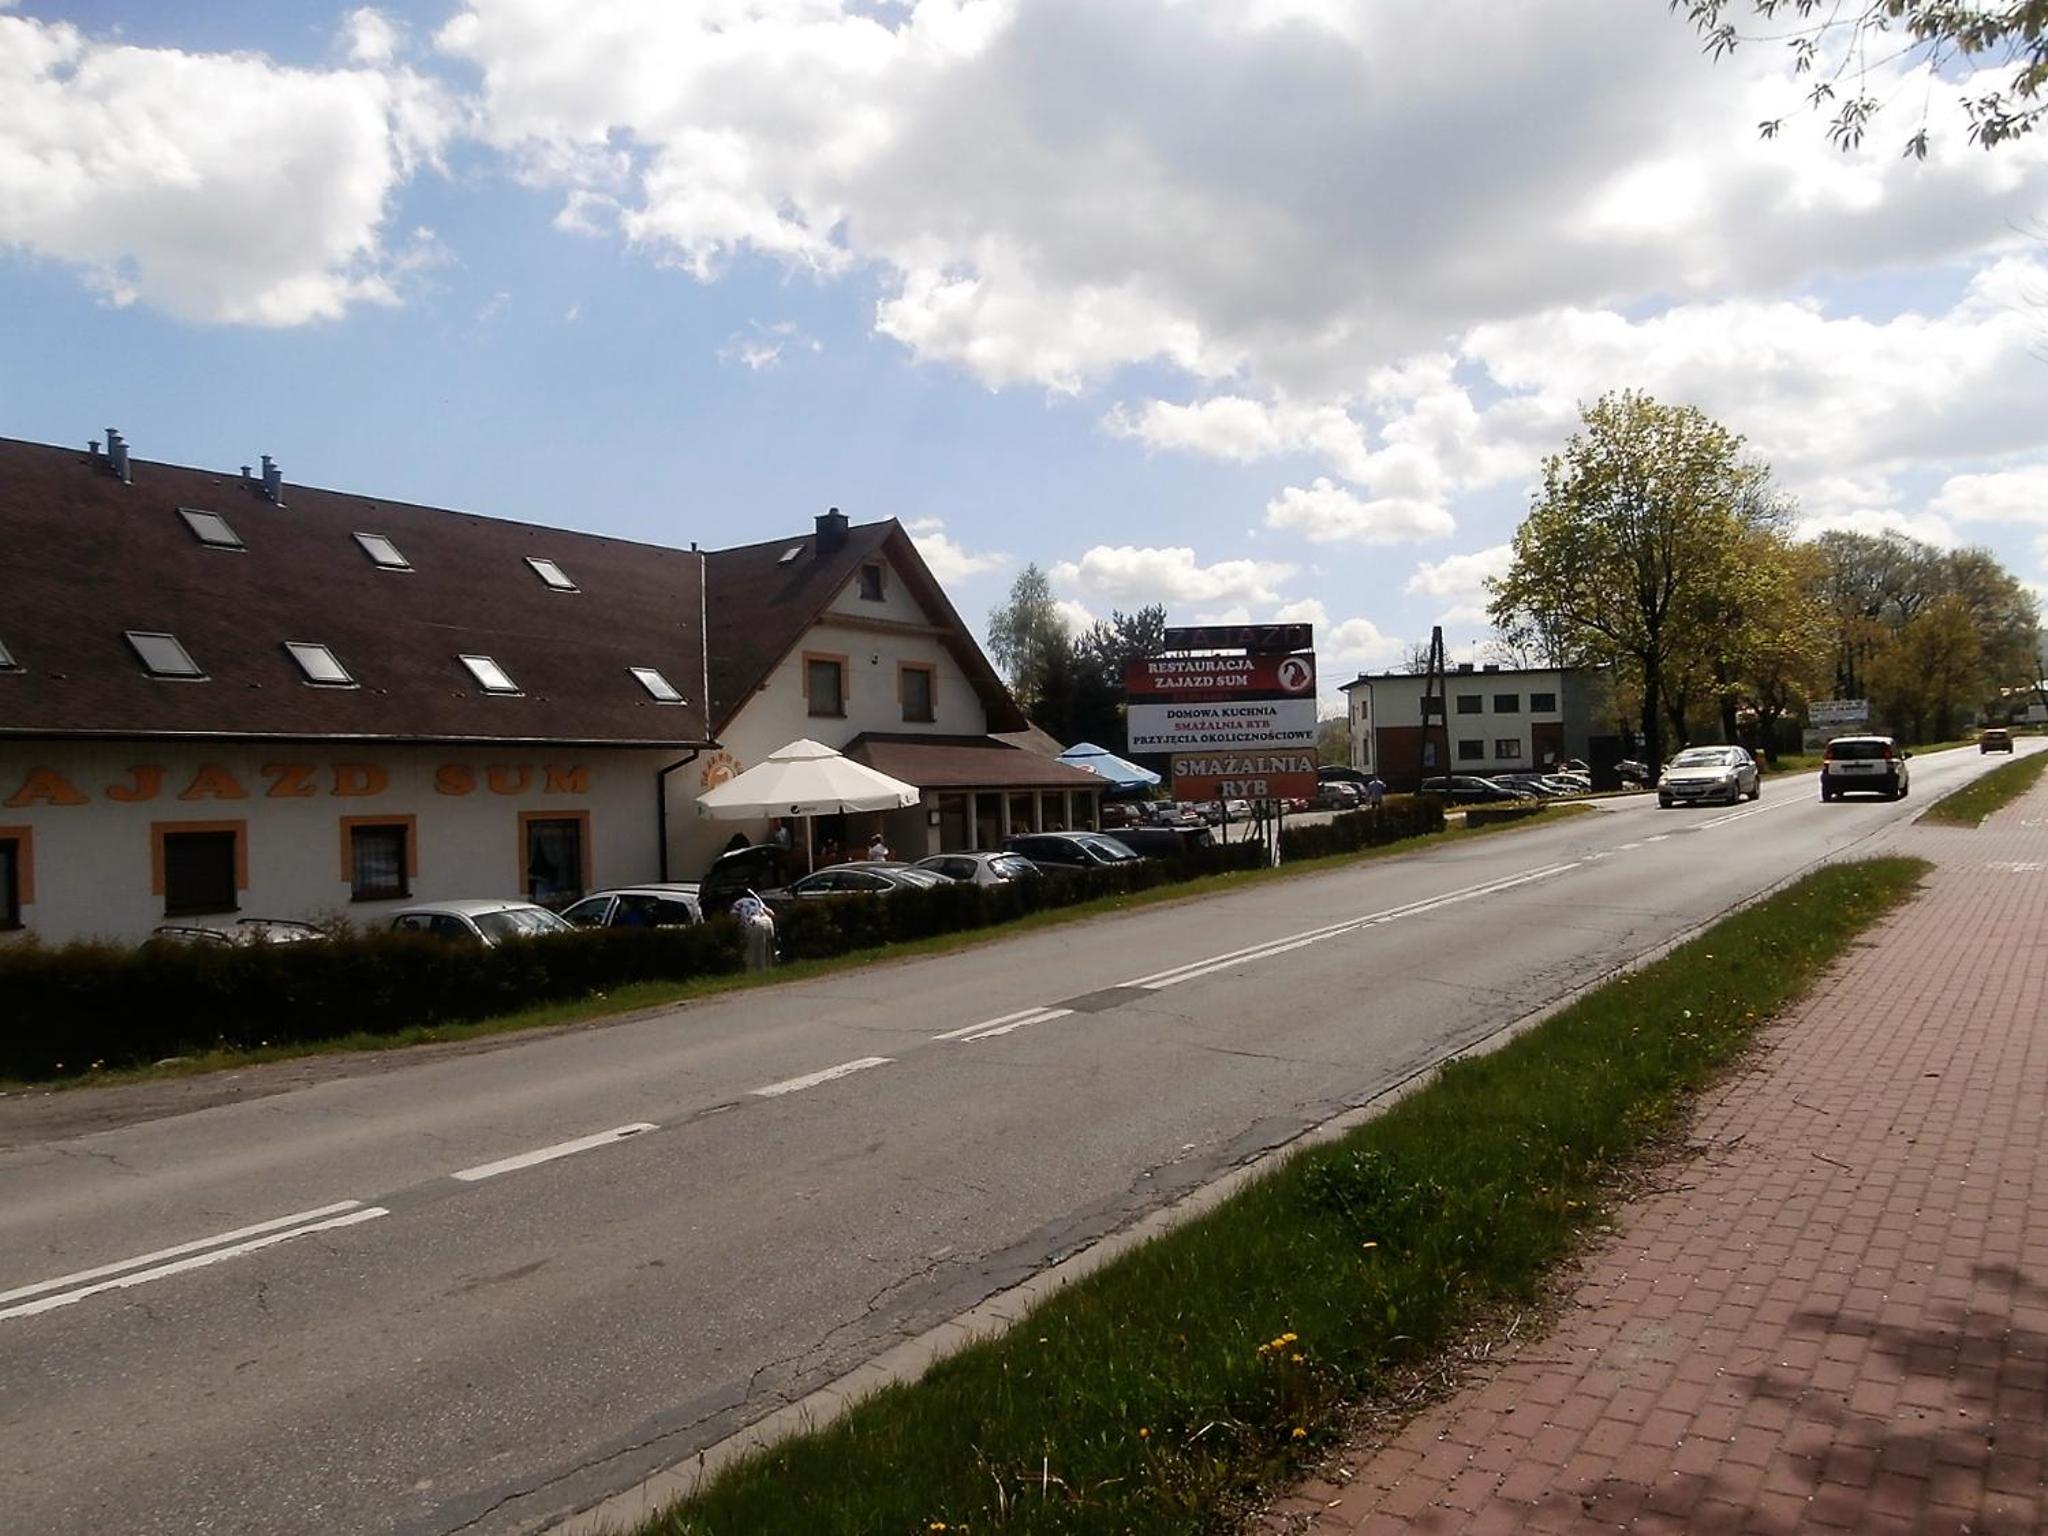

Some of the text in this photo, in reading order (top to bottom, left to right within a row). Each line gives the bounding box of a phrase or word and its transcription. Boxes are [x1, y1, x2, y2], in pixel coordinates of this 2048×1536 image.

[1148, 659, 1255, 674] RESTAURACJA
[1155, 675, 1249, 689] ZAJAZD SUM
[1167, 706, 1277, 719] DOMOWA KUCHNIA
[1174, 719, 1270, 731] SMAŻALNIA RYB
[1133, 730, 1313, 746] PRZYJĘCIA OKOLICZNOŚCIOWE
[1174, 755, 1313, 776] SMAŻALNIA
[434, 763, 592, 797] SUM
[1221, 780, 1269, 797] RYB
